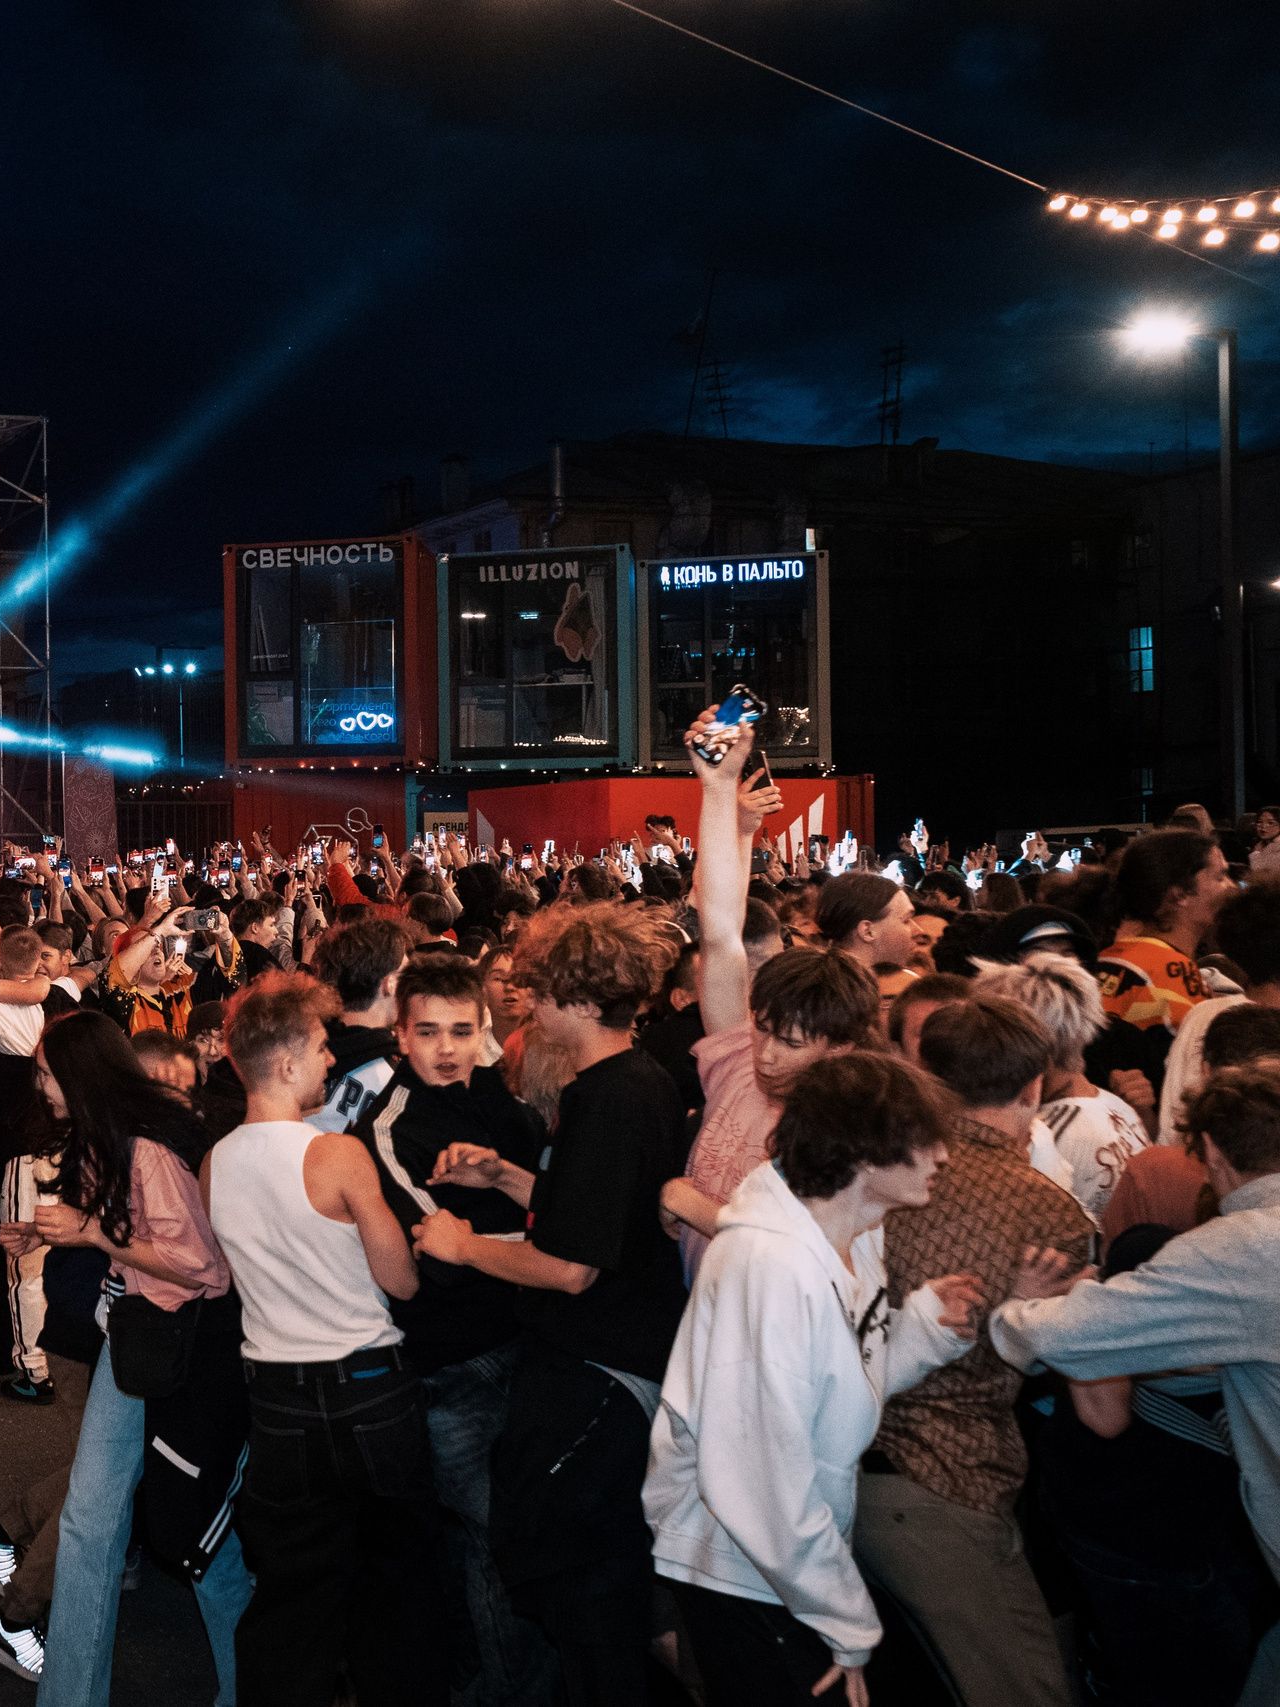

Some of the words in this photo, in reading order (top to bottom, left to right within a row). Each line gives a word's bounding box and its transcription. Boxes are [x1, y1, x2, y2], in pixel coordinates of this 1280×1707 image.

[242, 543, 394, 569] СВЕЧНОСТЬ
[479, 561, 579, 582] ILLUZION
[674, 565, 717, 584] КОНЬ
[722, 564, 734, 582] В
[738, 560, 804, 581] ПАЛЬТО
